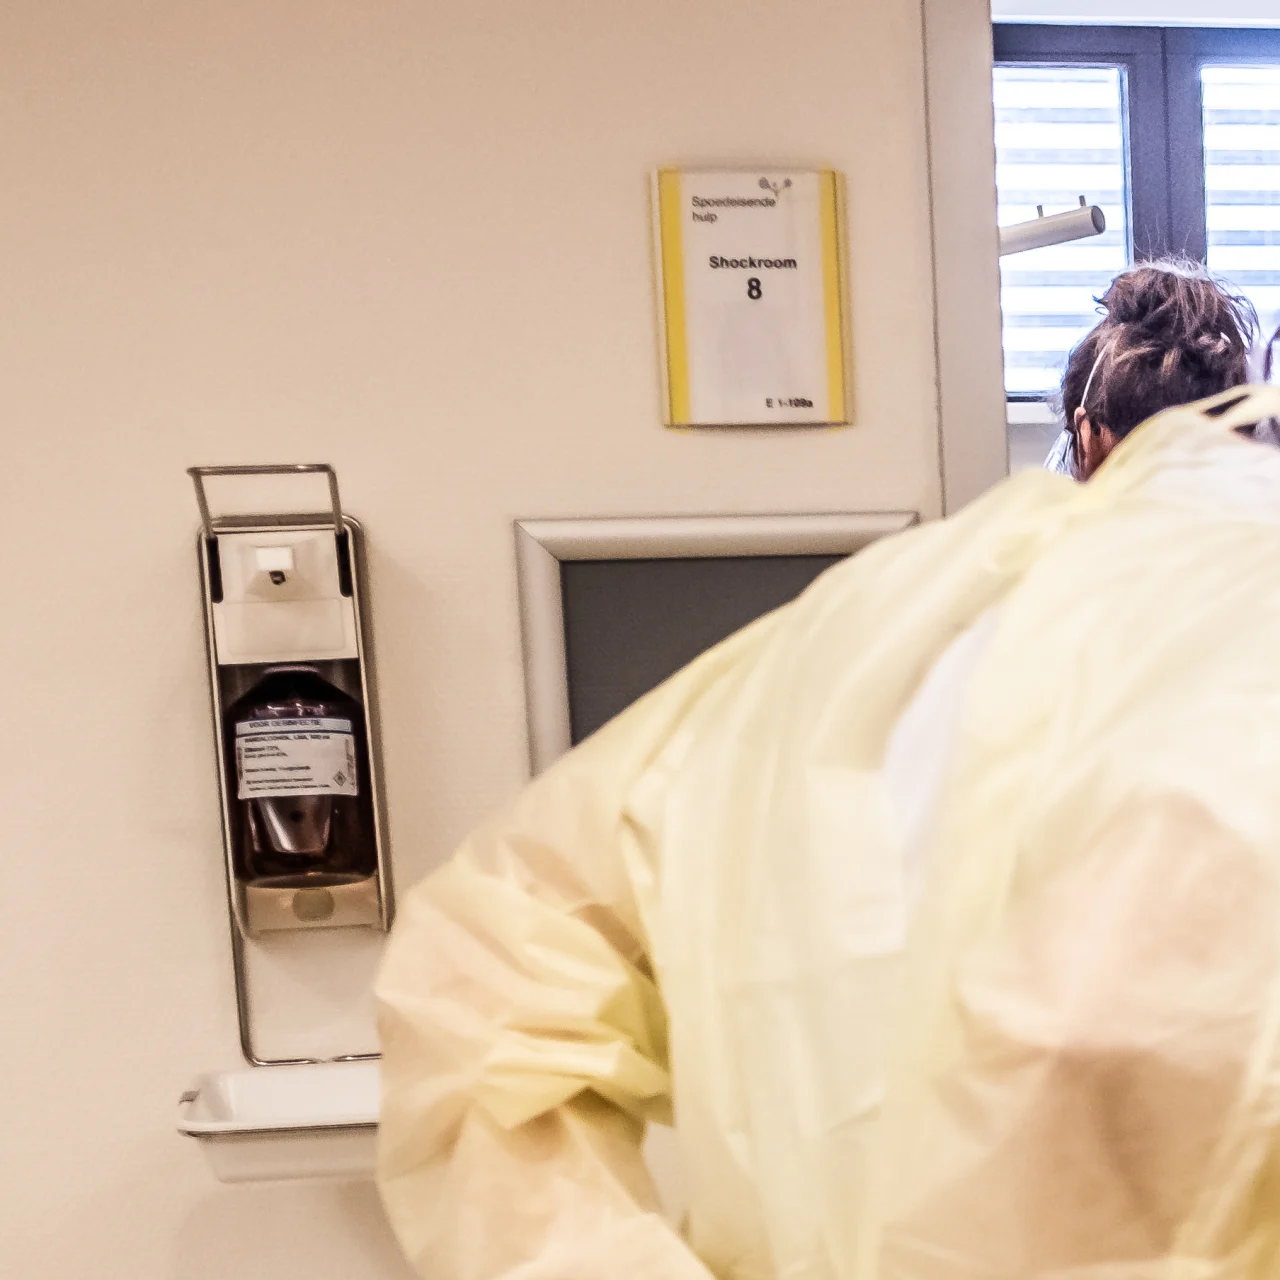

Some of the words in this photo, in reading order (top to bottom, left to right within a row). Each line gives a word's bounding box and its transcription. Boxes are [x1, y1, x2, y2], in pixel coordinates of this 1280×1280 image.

[692, 196, 776, 209] Spoedeisende
[692, 212, 718, 224] hulp
[709, 255, 798, 270] Shockroom
[747, 277, 763, 300] 8
